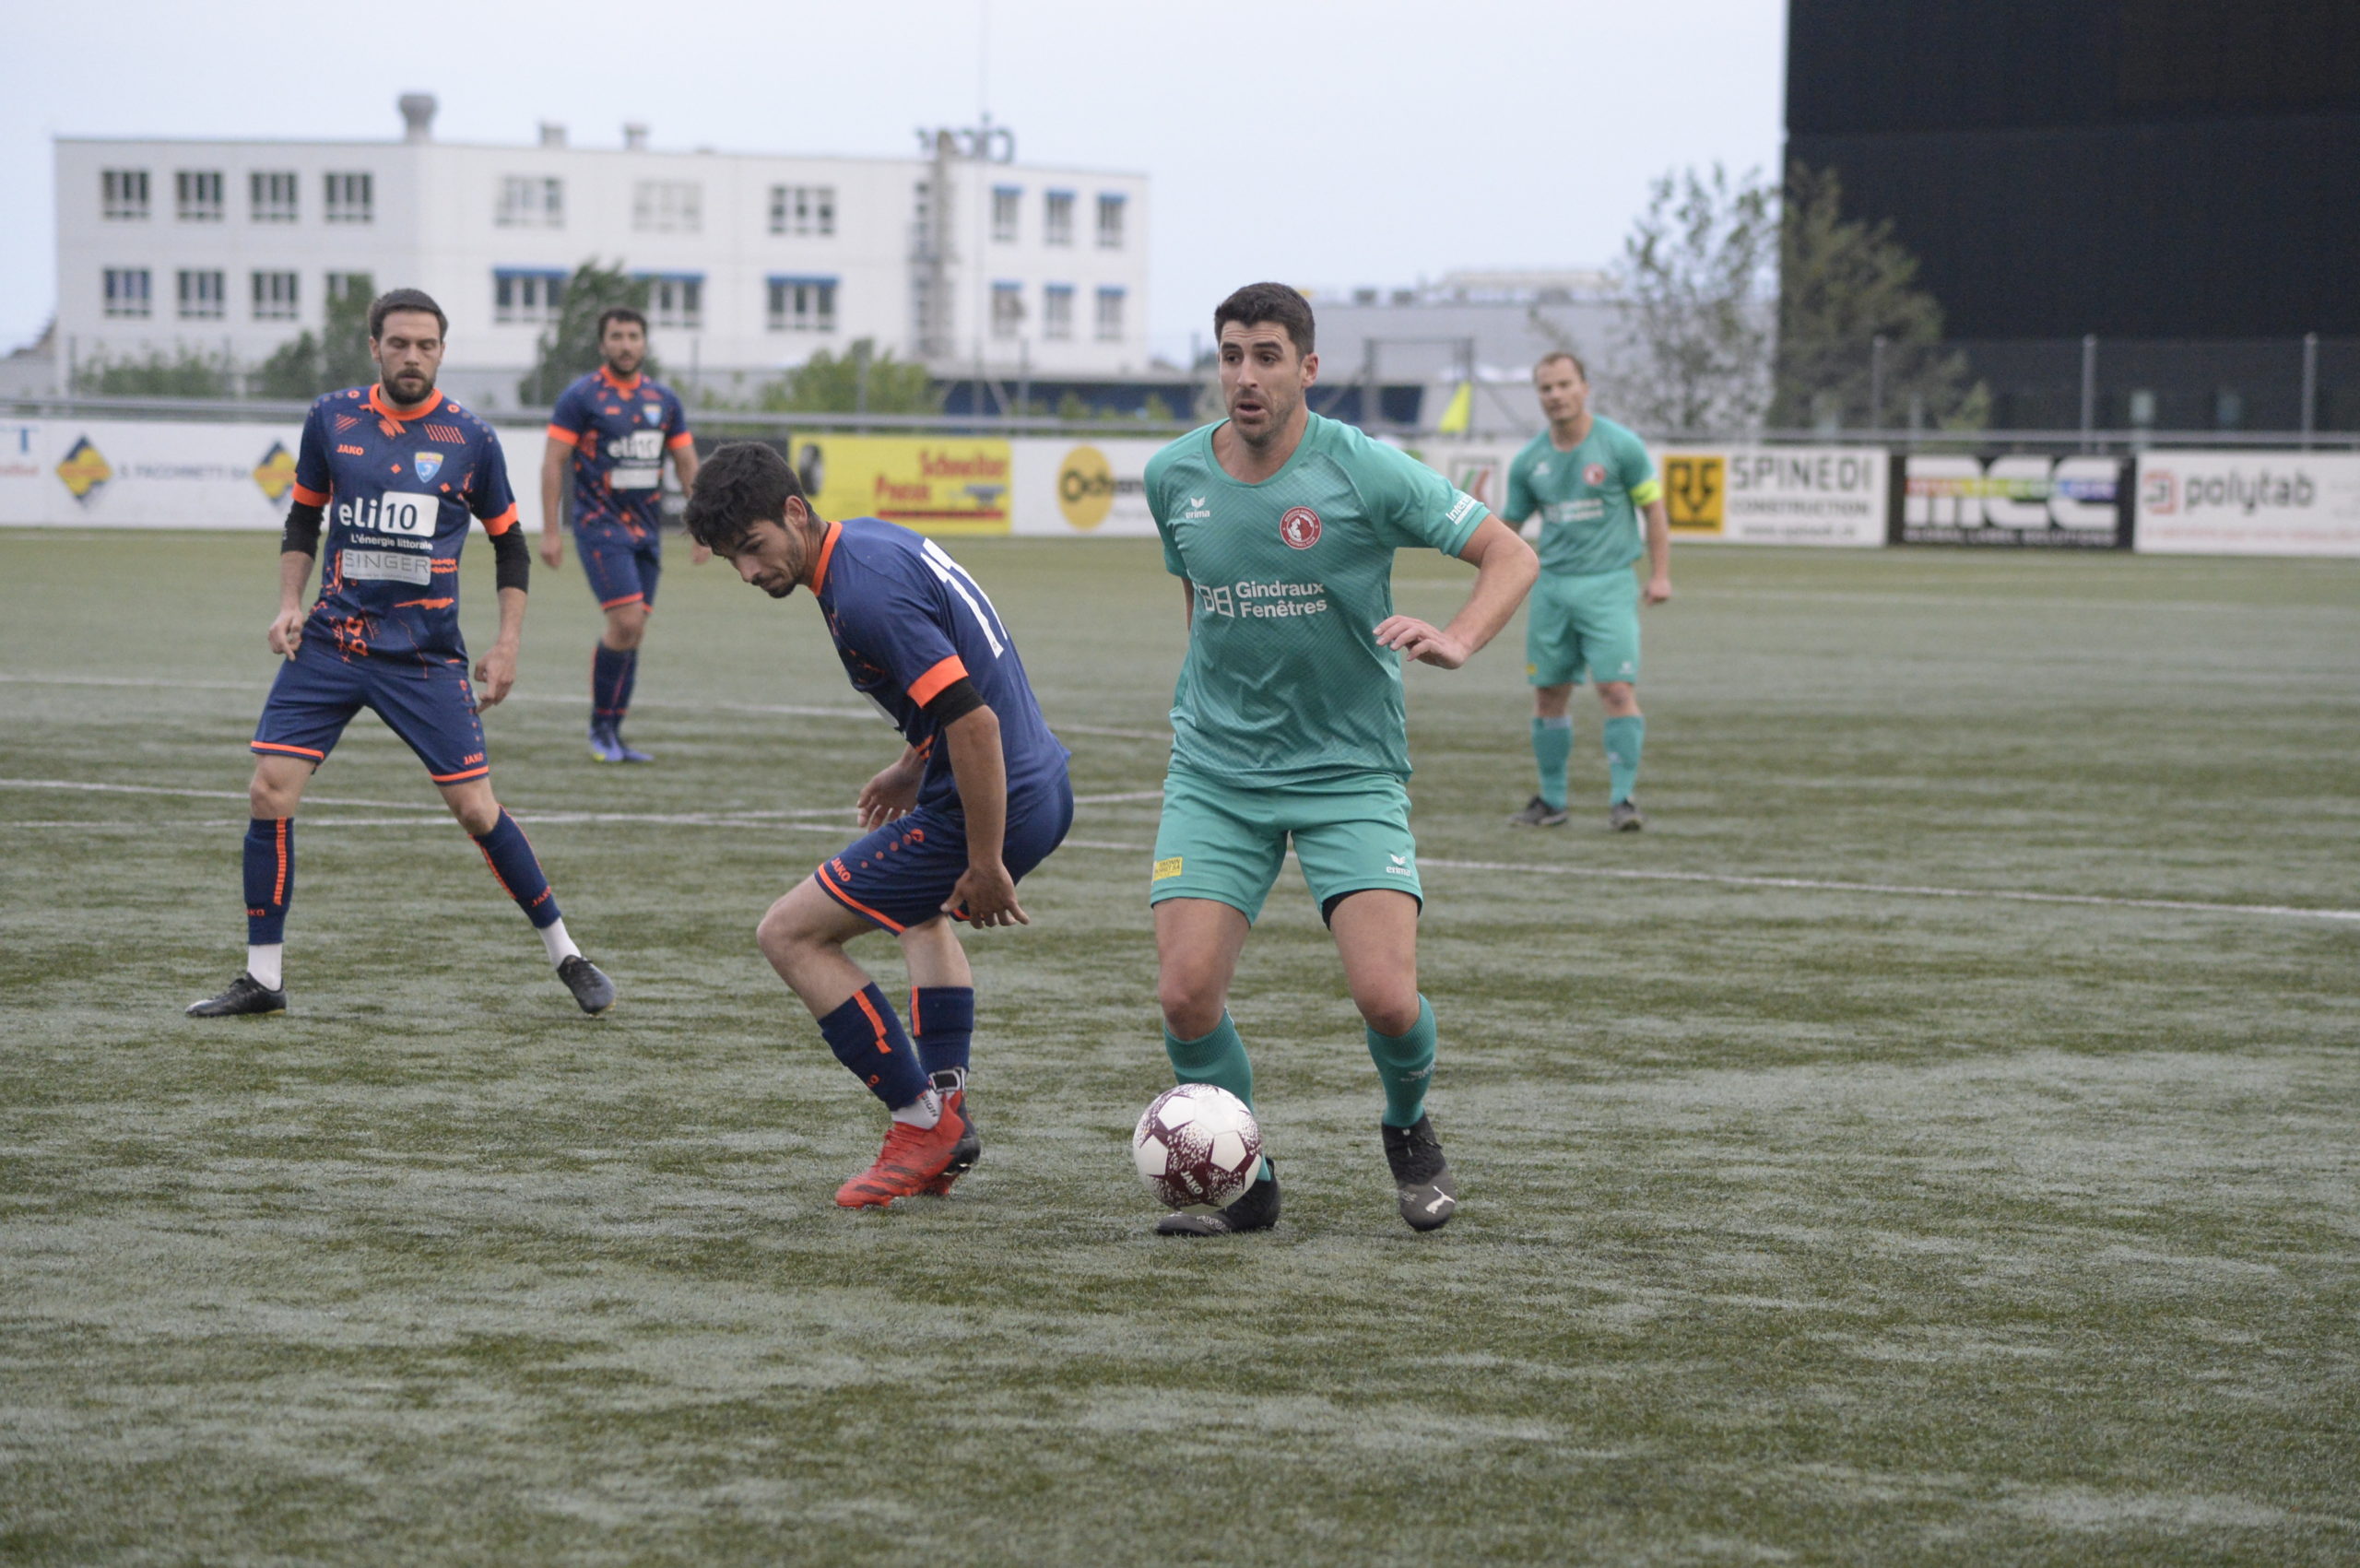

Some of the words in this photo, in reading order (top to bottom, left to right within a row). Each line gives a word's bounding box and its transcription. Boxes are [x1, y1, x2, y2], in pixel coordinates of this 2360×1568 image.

[336, 444, 364, 456] JAKO
[1731, 455, 1873, 491] SPINEDI
[2185, 467, 2315, 516] polytab
[350, 533, 395, 548] L'énergie
[397, 538, 433, 550] littorale
[344, 553, 429, 573] SINGER
[1235, 580, 1326, 599] Gindraux
[1240, 599, 1328, 618] Fenêtres
[831, 856, 851, 882] JAKO
[1386, 866, 1412, 877] erima
[1180, 1171, 1203, 1194] JAKO
